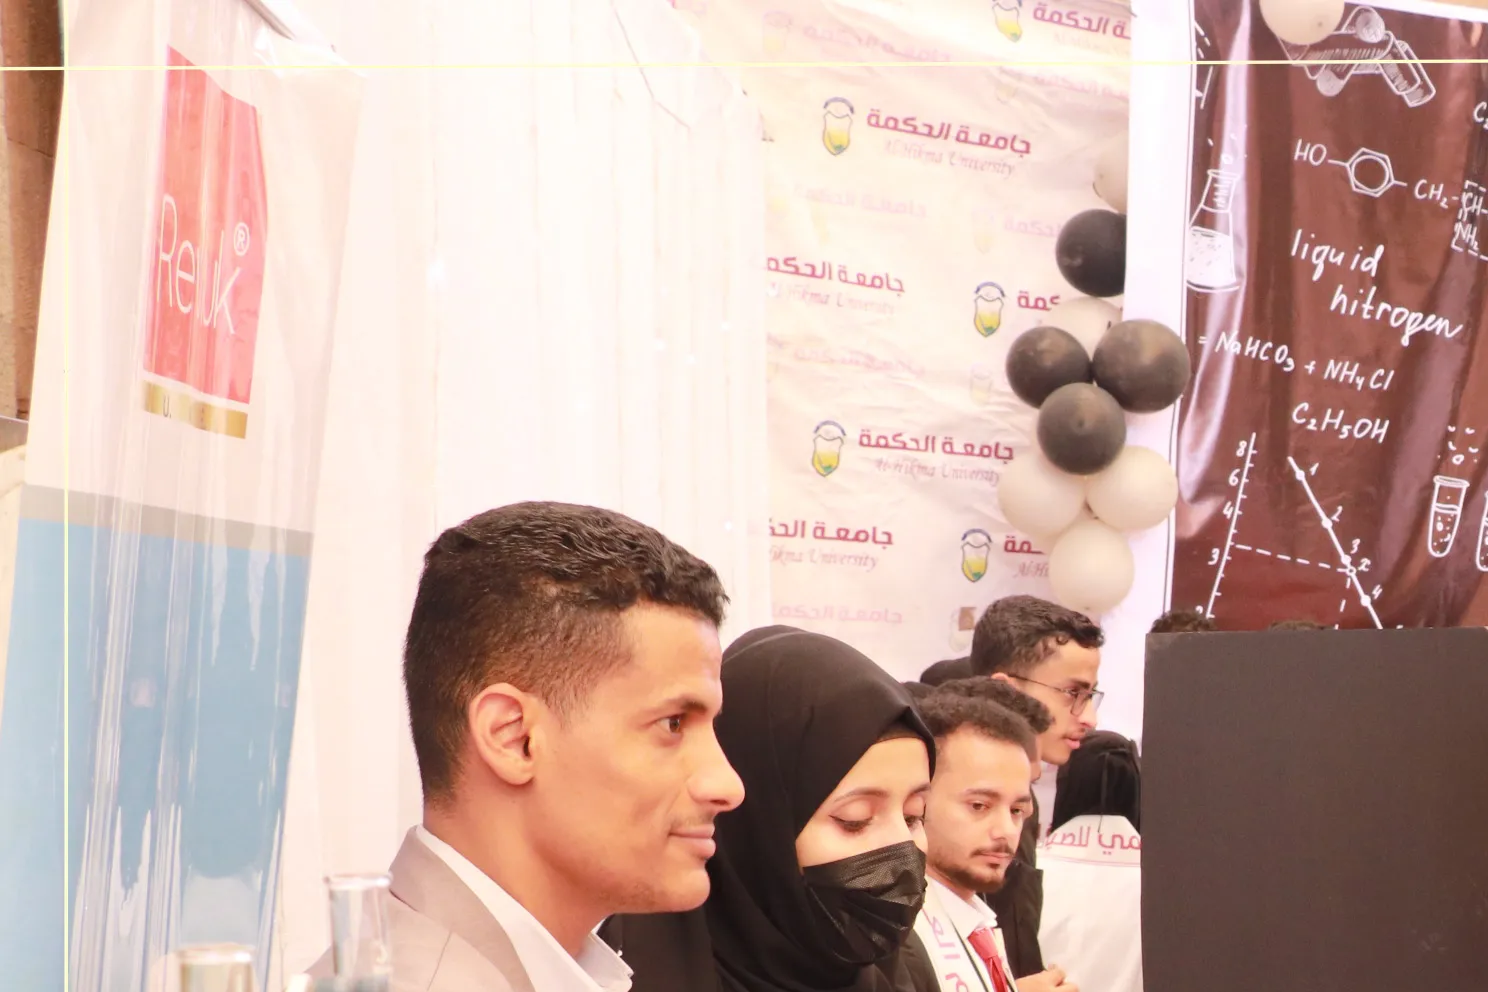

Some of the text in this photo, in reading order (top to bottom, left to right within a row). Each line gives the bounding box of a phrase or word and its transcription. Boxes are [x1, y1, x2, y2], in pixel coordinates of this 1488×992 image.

[867, 109, 1031, 156] جامعة الحكمة
[1294, 139, 1328, 166] HO
[1290, 228, 1386, 282] liquid
[767, 257, 905, 295] جامعة الحكم
[1291, 402, 1391, 445] C2H5OH
[858, 428, 1014, 465] جامعة الحكمة
[1236, 440, 1248, 458] 8
[1228, 468, 1239, 486] 6
[812, 521, 894, 550] جامعة
